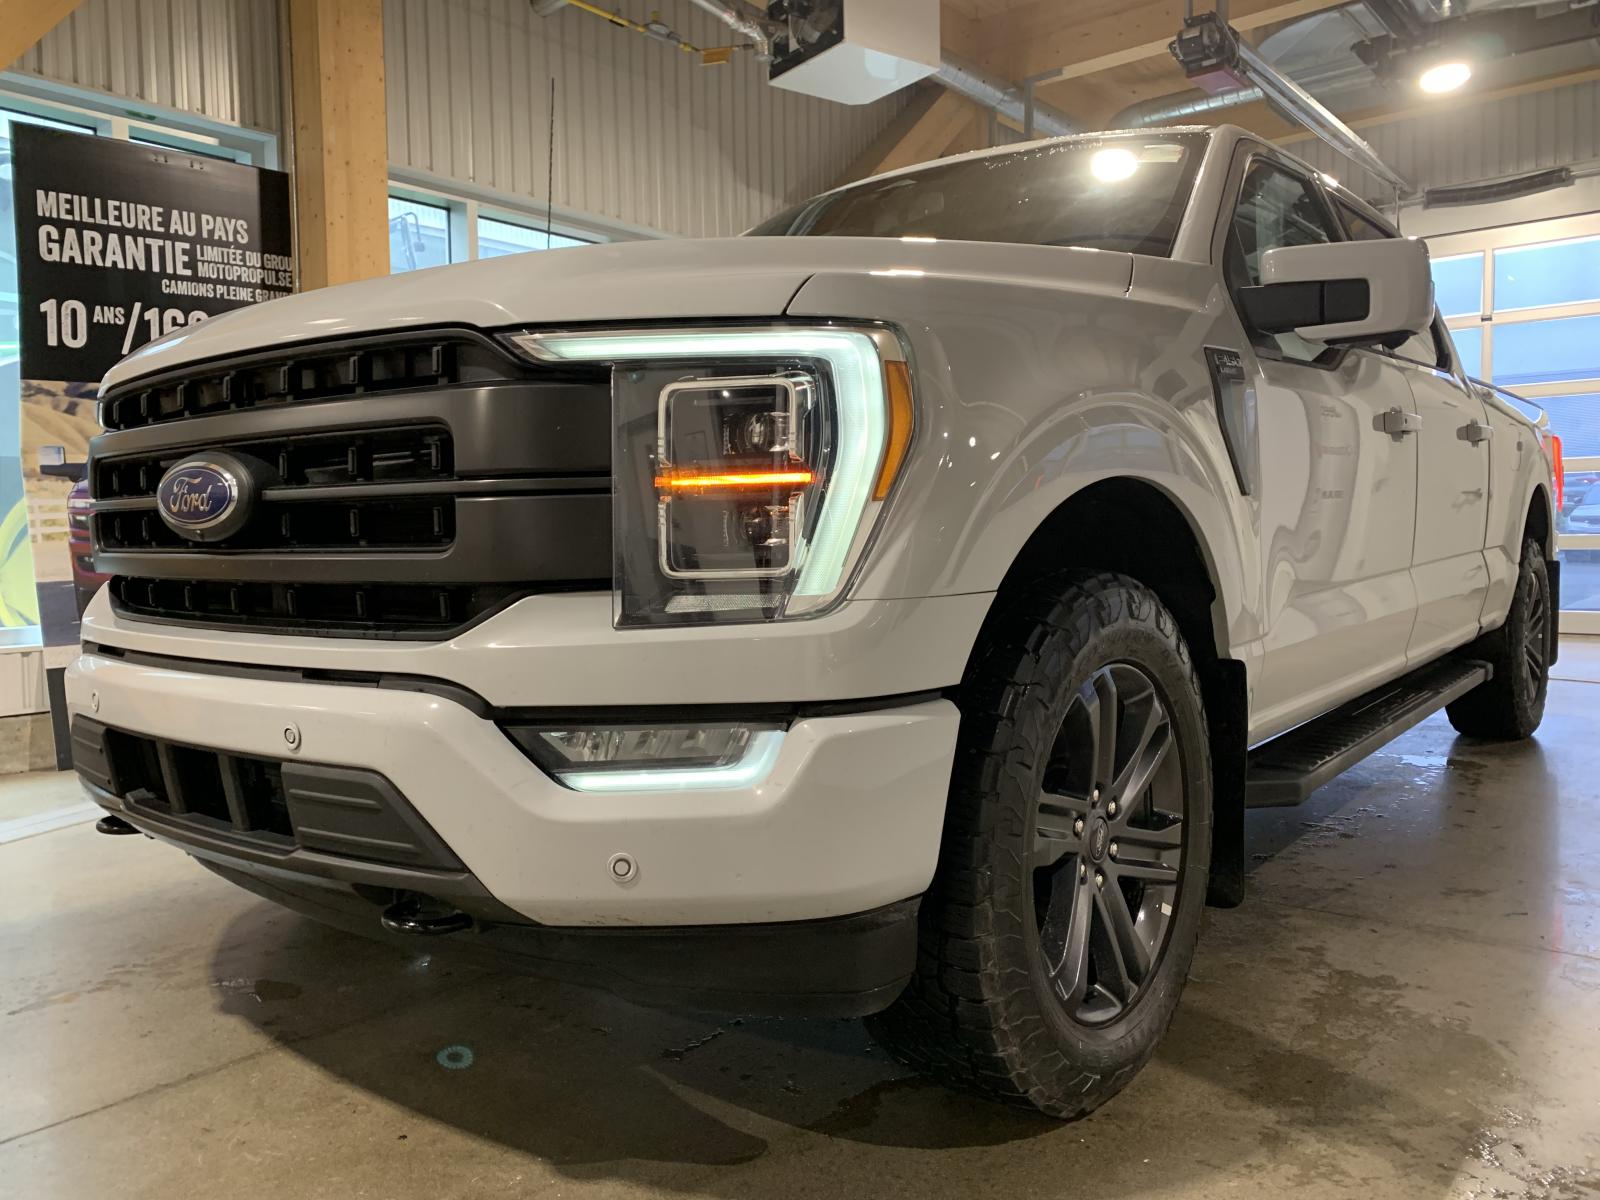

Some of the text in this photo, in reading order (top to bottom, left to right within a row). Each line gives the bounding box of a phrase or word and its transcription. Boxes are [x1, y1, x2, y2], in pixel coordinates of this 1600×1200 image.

[36, 189, 249, 244] MEILLEURE AU PAYS
[38, 224, 192, 276] GARANTIE
[196, 244, 244, 265] LIMITÉE
[245, 251, 262, 268] DU
[161, 279, 214, 298] CAMIONS
[216, 284, 254, 302] PLEINE
[197, 261, 292, 287] MOTOPROPULSE
[39, 298, 88, 349] 10
[93, 305, 125, 325] ANS
[169, 476, 213, 513] Ford
